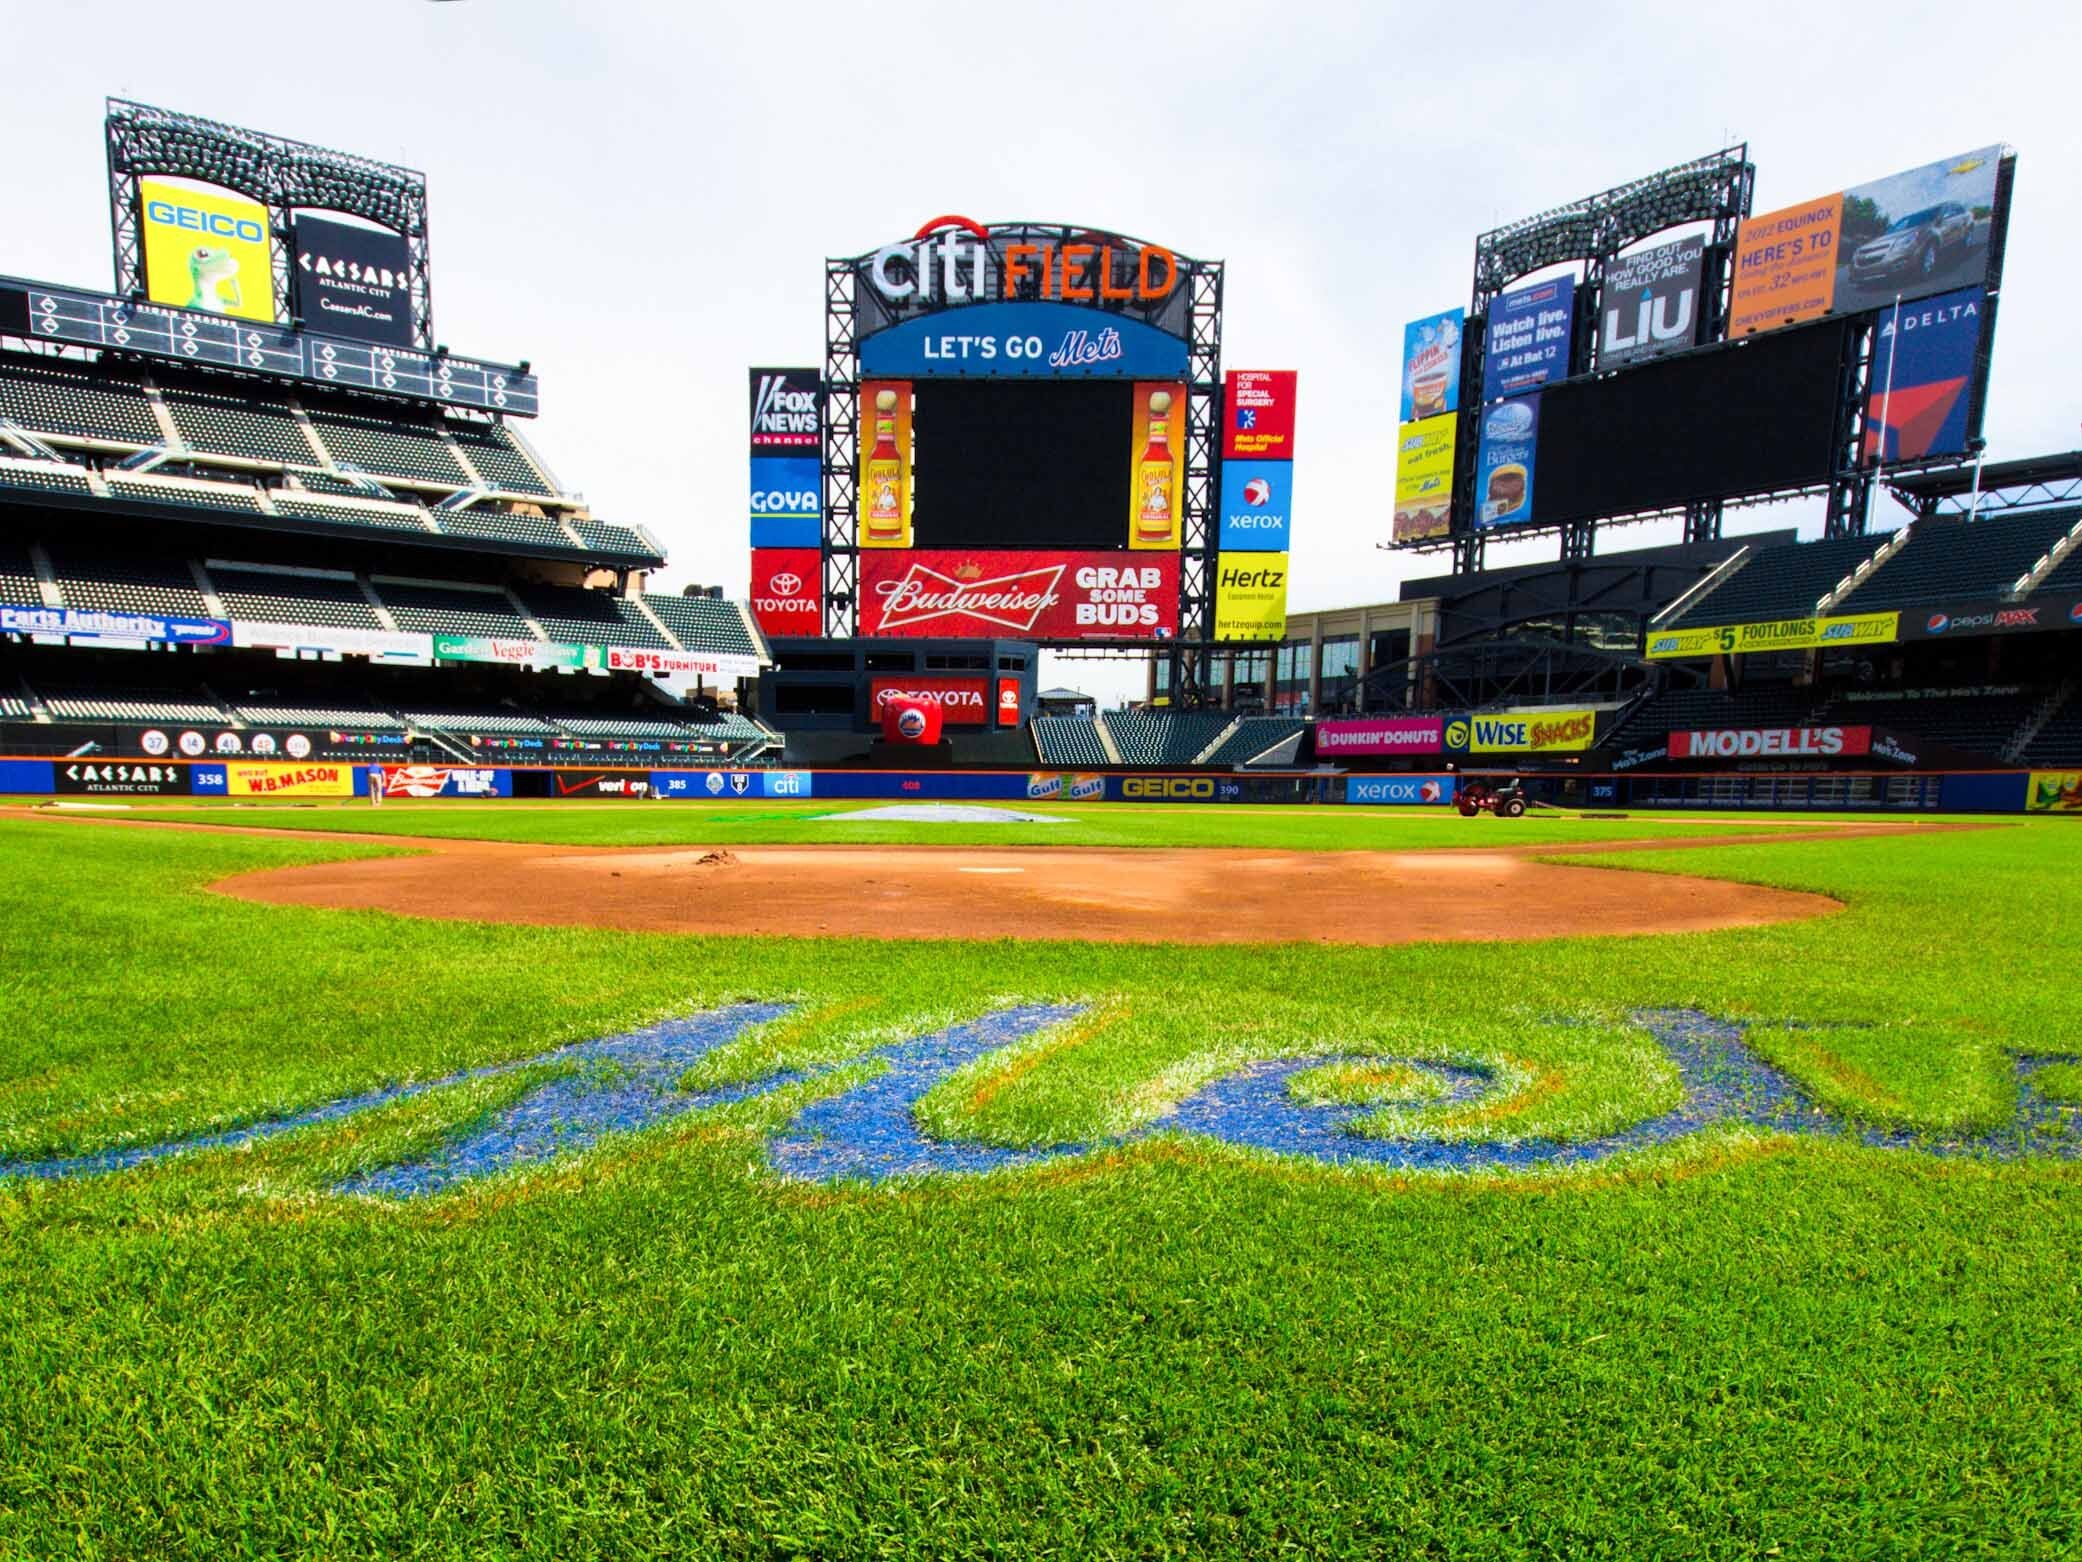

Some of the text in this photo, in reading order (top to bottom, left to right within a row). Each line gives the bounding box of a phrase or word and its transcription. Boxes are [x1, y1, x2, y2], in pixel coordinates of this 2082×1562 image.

[148, 201, 264, 243] GEICO
[1745, 207, 1834, 243] 2012 EQUINOX
[1626, 242, 1682, 269] FIND OUT
[1741, 229, 1832, 269] HERE'S TO
[299, 253, 408, 290] CAESARS
[1004, 244, 1177, 299] FIELD
[1606, 247, 1703, 284] HOW GOOD YOU
[320, 278, 391, 298] ATLANTIC CITY
[1616, 271, 1659, 292] REALLY
[1769, 271, 1791, 290] 32
[320, 298, 392, 322] CaesarsAC.com
[1904, 303, 1977, 331] DELTA
[1493, 309, 1567, 338] Watch live.
[924, 327, 1121, 367] LET'S GO Mets
[1492, 326, 1565, 355] Listen live.
[1510, 346, 1556, 368] At Bat 12
[1237, 373, 1272, 381] HOSPITAL
[773, 391, 817, 413] FOX
[1236, 398, 1276, 407] SURGERY
[1237, 390, 1271, 398] SPECIAL
[761, 413, 818, 433] NEWS
[753, 436, 819, 444] channel
[1235, 434, 1284, 443] Mets Official
[751, 491, 818, 512] GOYA
[1229, 515, 1283, 529] xerox
[1076, 567, 1161, 589] GRAB
[1221, 568, 1284, 588] Hertz
[754, 599, 818, 612] TOYOTA
[876, 579, 1059, 613] Budweiser
[1090, 589, 1146, 603] SOME
[1076, 603, 1159, 625] BUDS
[1951, 613, 1994, 629] pepsi
[1218, 620, 1282, 631] hertzequip.com
[1742, 620, 1816, 640] FOOTLONGS
[1821, 617, 1894, 640] SUBWAY
[492, 640, 535, 661] Veggie
[1652, 632, 1714, 652] SUBWAY
[610, 650, 661, 669] BOB'S
[664, 660, 718, 673] FURNITURE
[1384, 729, 1438, 743] DONUTS
[1475, 714, 1590, 750] WISE SNACKS
[1688, 727, 1844, 757] MODELL'S
[149, 737, 162, 748] 37
[186, 738, 198, 748] 14
[257, 739, 270, 749] 42
[66, 764, 177, 783] CAESARS
[198, 773, 223, 785] 358
[87, 784, 160, 792] ATLANTIC CITY
[598, 778, 648, 795] verizon
[669, 780, 686, 790] 385
[774, 775, 799, 794] citi
[1030, 778, 1060, 797] Gulf
[1071, 779, 1102, 798] Gulf
[1123, 778, 1214, 797] GEICO
[1220, 785, 1239, 794] 390
[1357, 782, 1415, 799] xerox
[1593, 786, 1613, 797] 375
